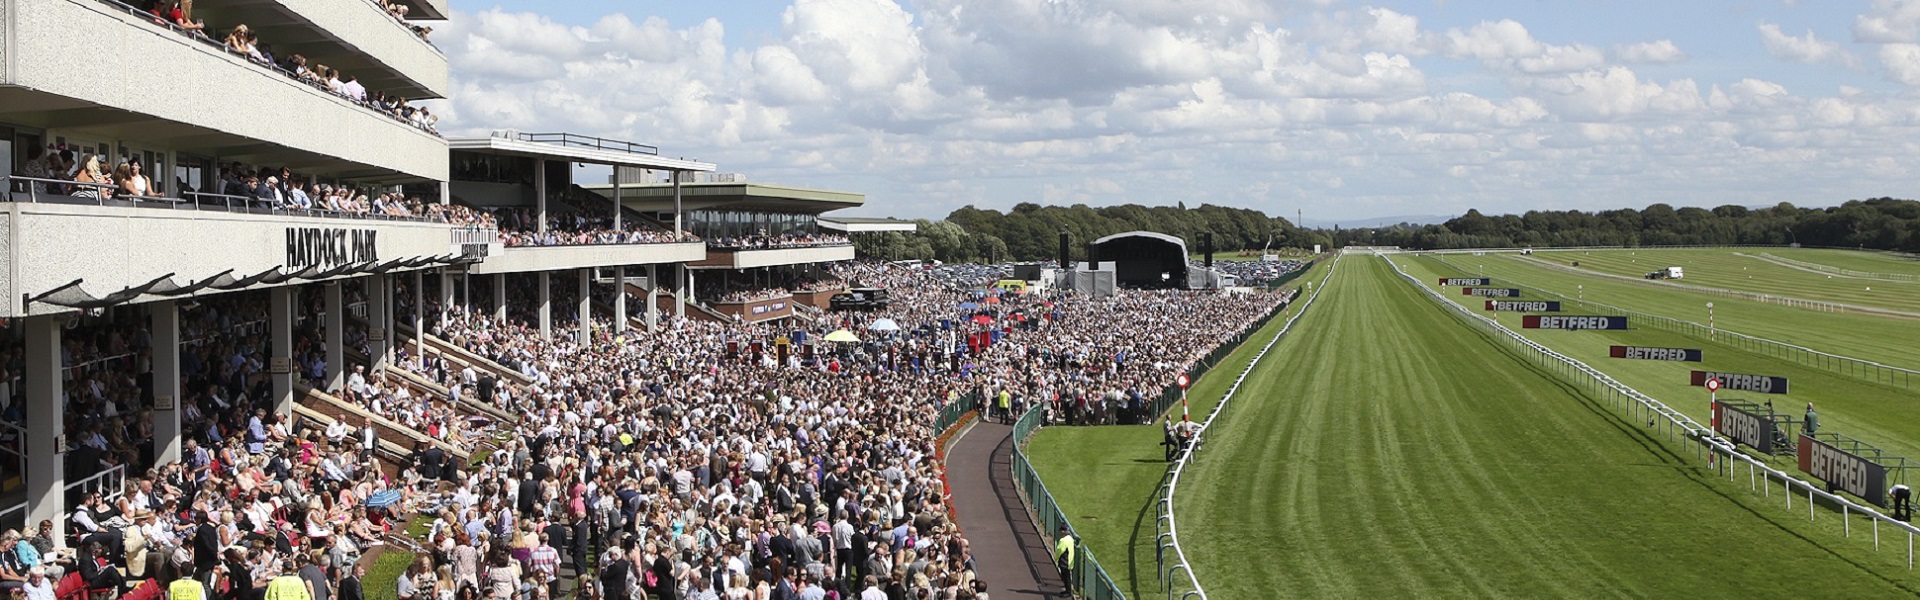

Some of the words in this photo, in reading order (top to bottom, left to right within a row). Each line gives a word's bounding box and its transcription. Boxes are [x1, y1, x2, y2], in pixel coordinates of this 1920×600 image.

[286, 228, 347, 271] HAYDOCK
[351, 229, 377, 264] PARK
[1447, 278, 1481, 286] BETFRED
[1471, 288, 1510, 297] BETFRED
[1497, 301, 1547, 311] BETFRED
[1539, 316, 1609, 329] BETFRED
[1625, 347, 1687, 361] BETFRED
[1721, 406, 1761, 449] BETFRED
[1811, 442, 1867, 498] BETFRED
